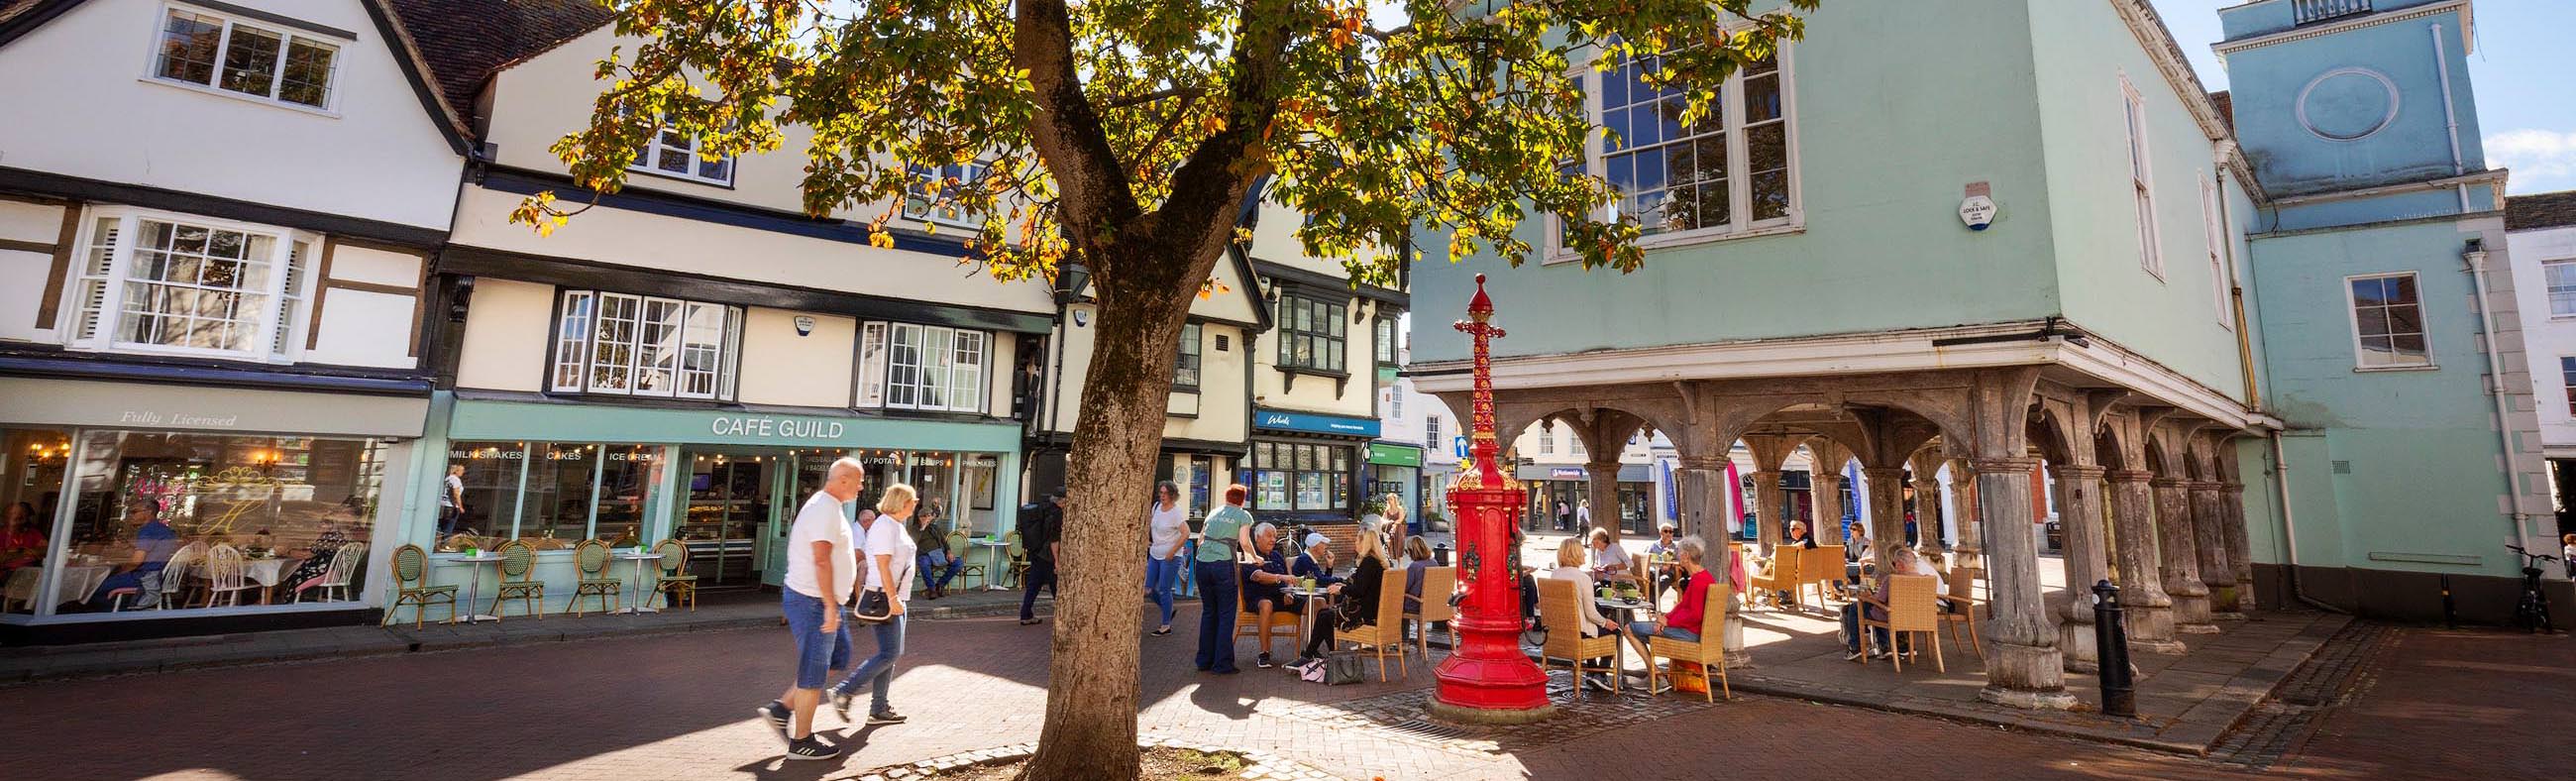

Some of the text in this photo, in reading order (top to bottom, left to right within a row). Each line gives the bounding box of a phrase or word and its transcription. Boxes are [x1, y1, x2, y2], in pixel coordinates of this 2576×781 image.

[120, 411, 238, 427] Fully Licensed
[712, 415, 844, 438] CAFÉ GUILD
[449, 450, 524, 460] MILK SHAKES
[609, 452, 626, 462] ICE
